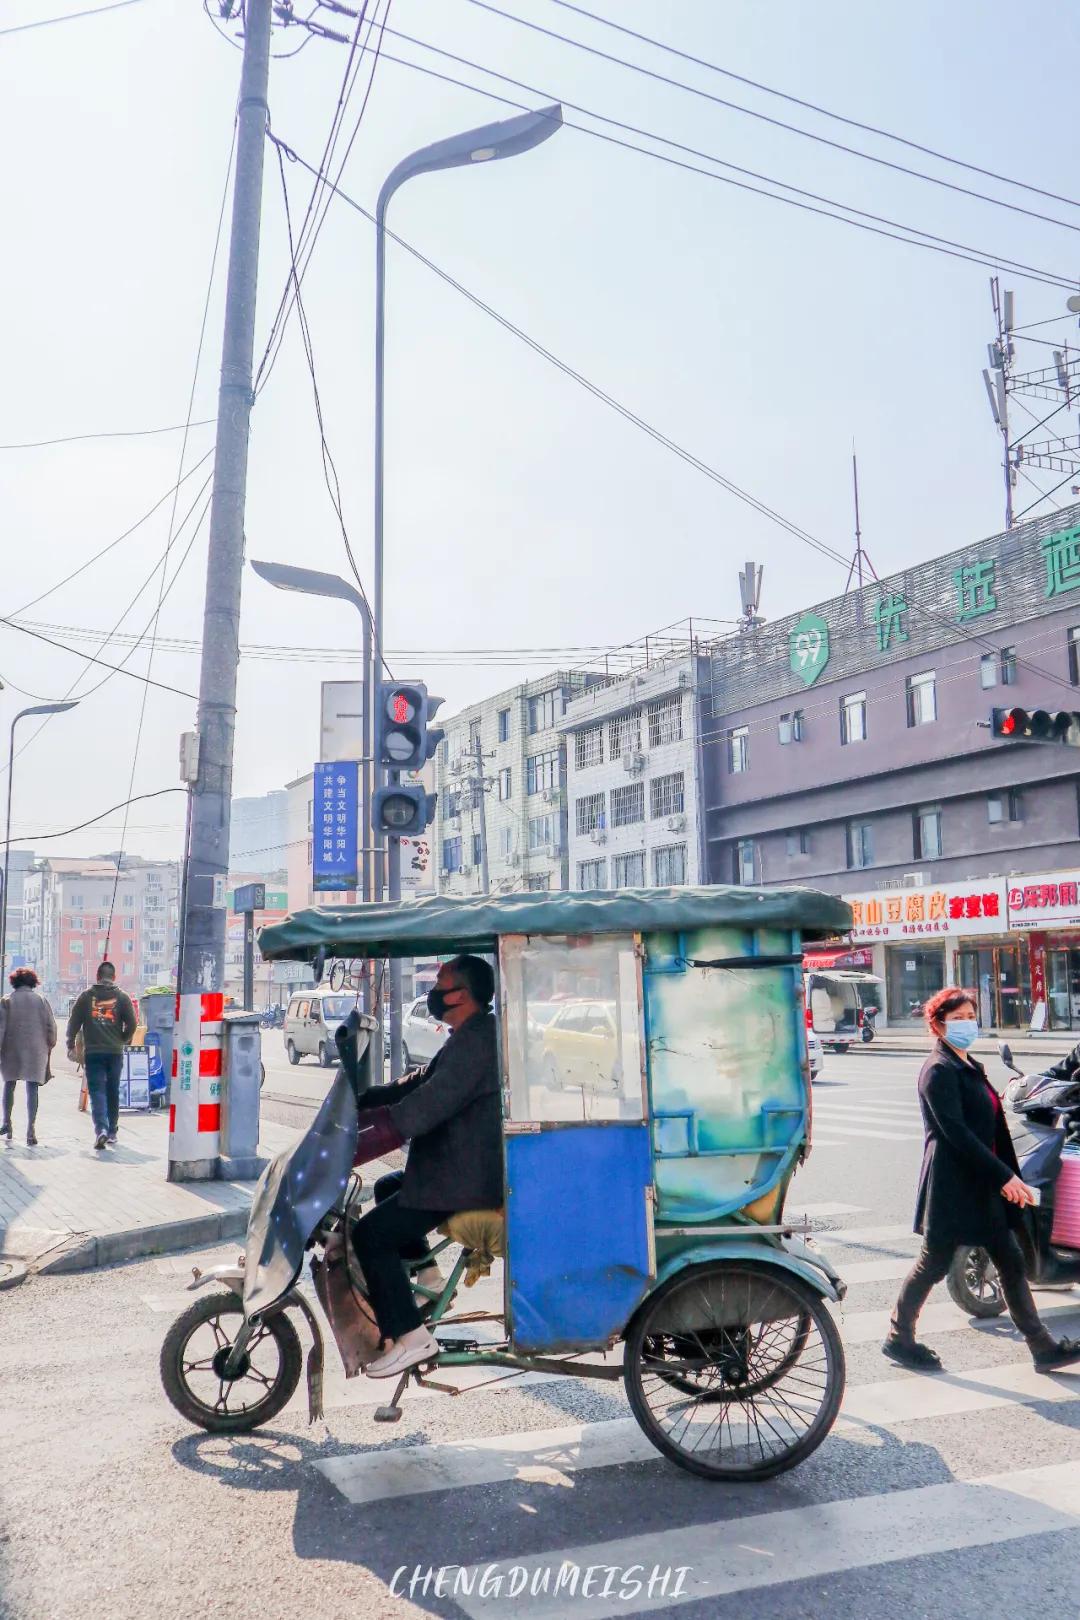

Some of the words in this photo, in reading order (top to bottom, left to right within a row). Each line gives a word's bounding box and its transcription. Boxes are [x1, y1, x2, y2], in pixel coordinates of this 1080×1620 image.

[796, 628, 821, 667] 99
[323, 776, 333, 862] 共建文明华阳城
[336, 775, 346, 862] 争当文明华阳人
[1024, 881, 1080, 909] 乐邦厨
